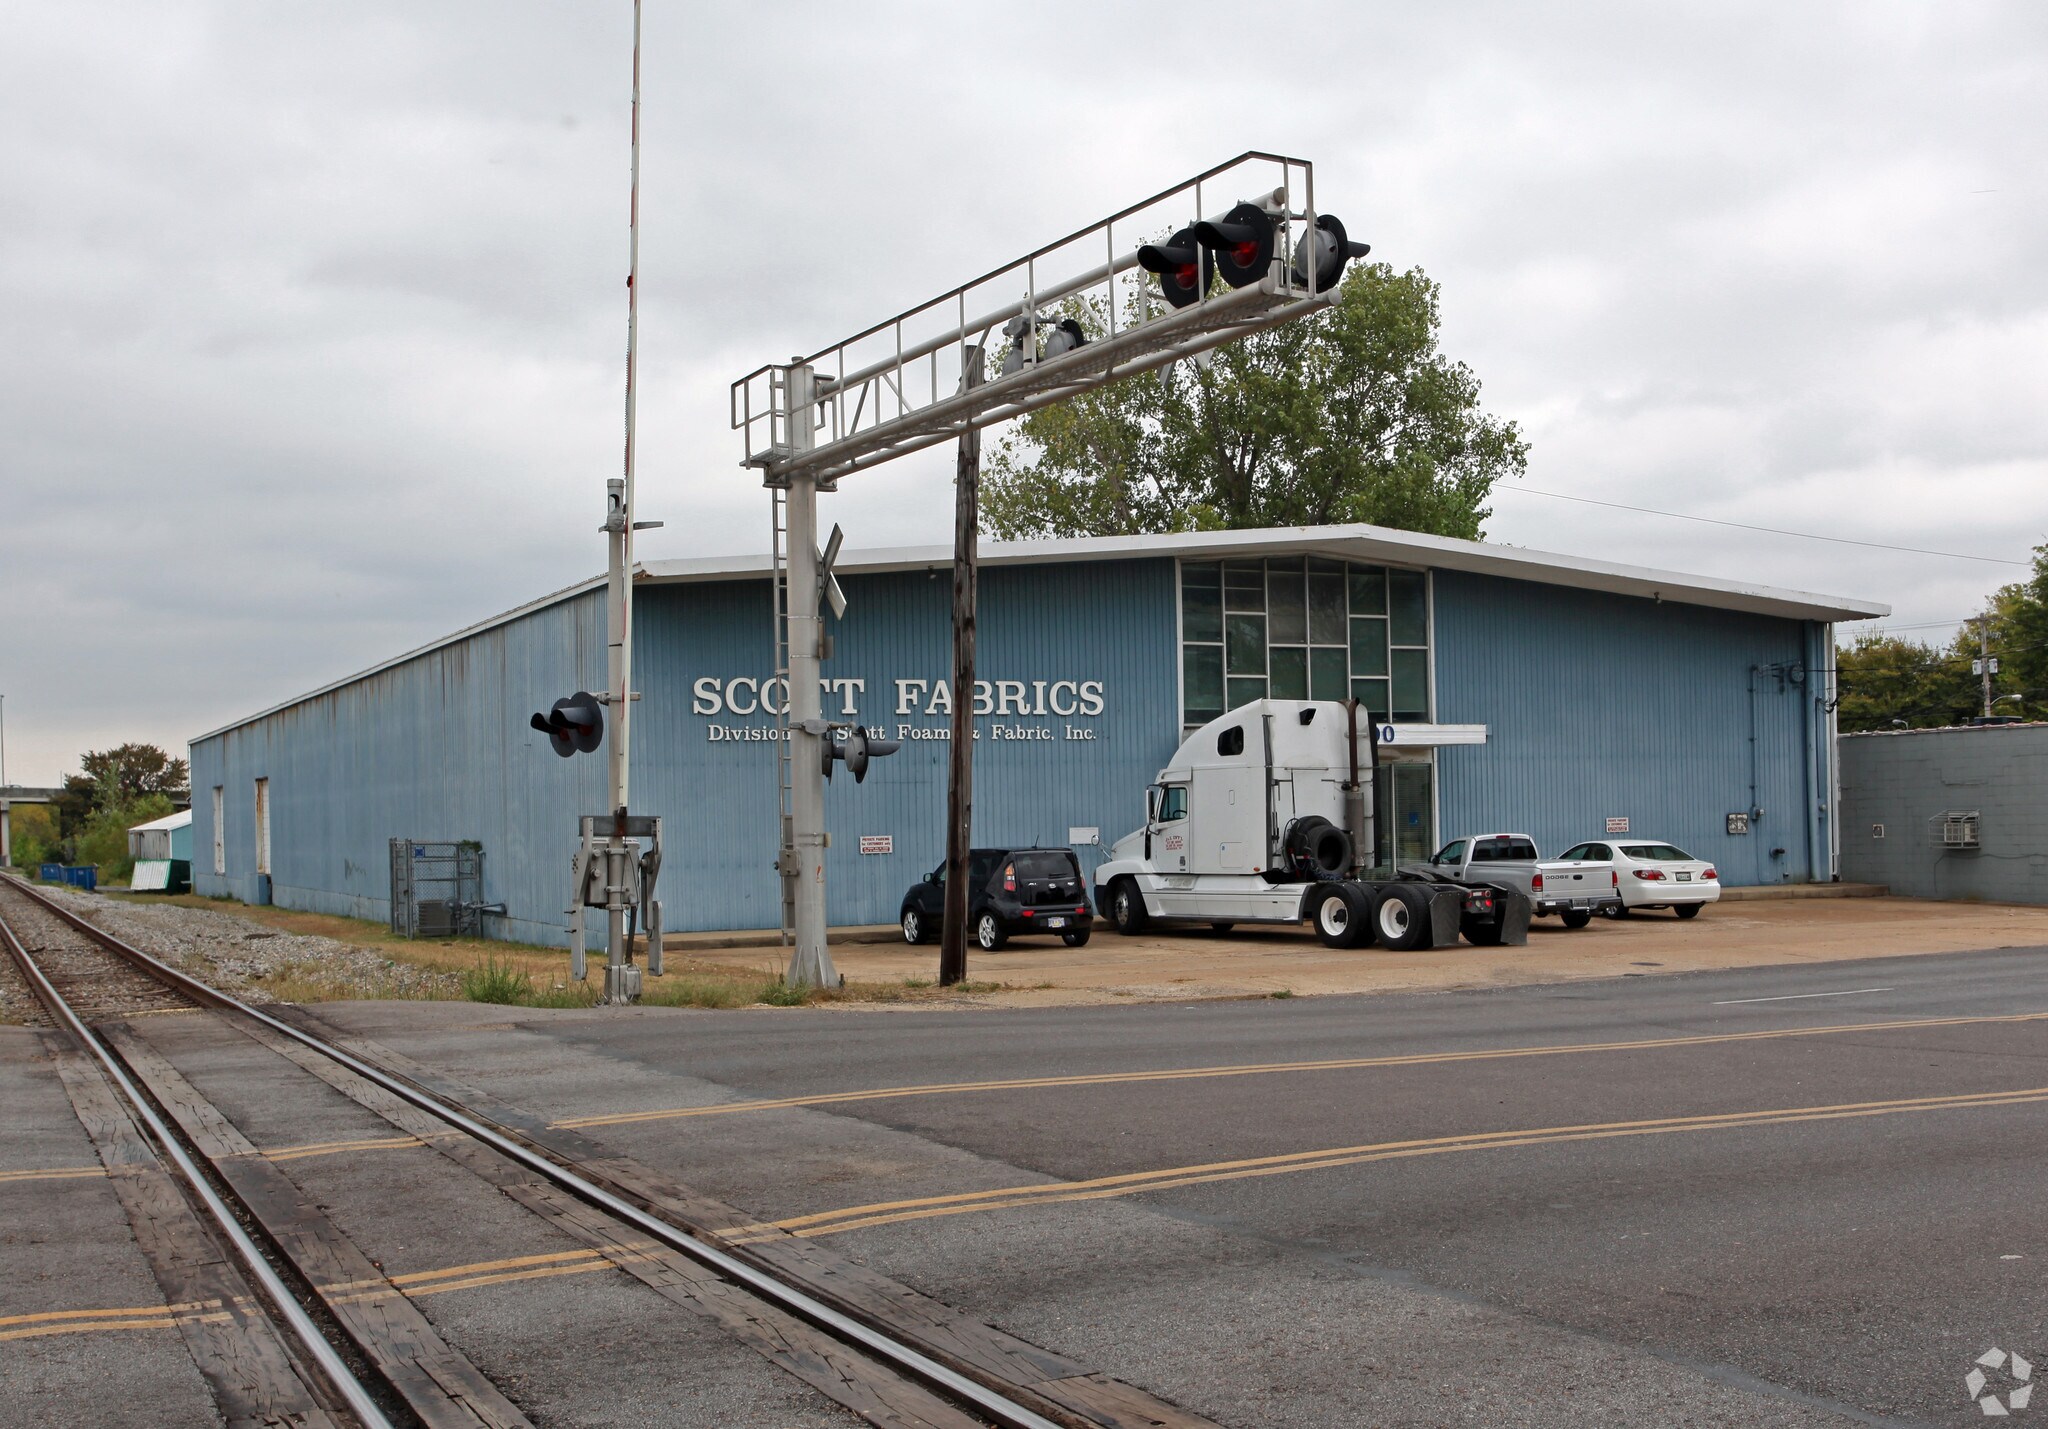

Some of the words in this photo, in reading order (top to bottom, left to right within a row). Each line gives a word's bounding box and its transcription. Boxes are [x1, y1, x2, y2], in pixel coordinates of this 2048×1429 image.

[693, 677, 865, 715] SCOT
[895, 679, 1104, 716] FABRICS
[836, 725, 886, 740] Stt
[897, 724, 951, 740] Foam
[991, 724, 1054, 741] Fabric,
[1065, 724, 1097, 740] Inc.
